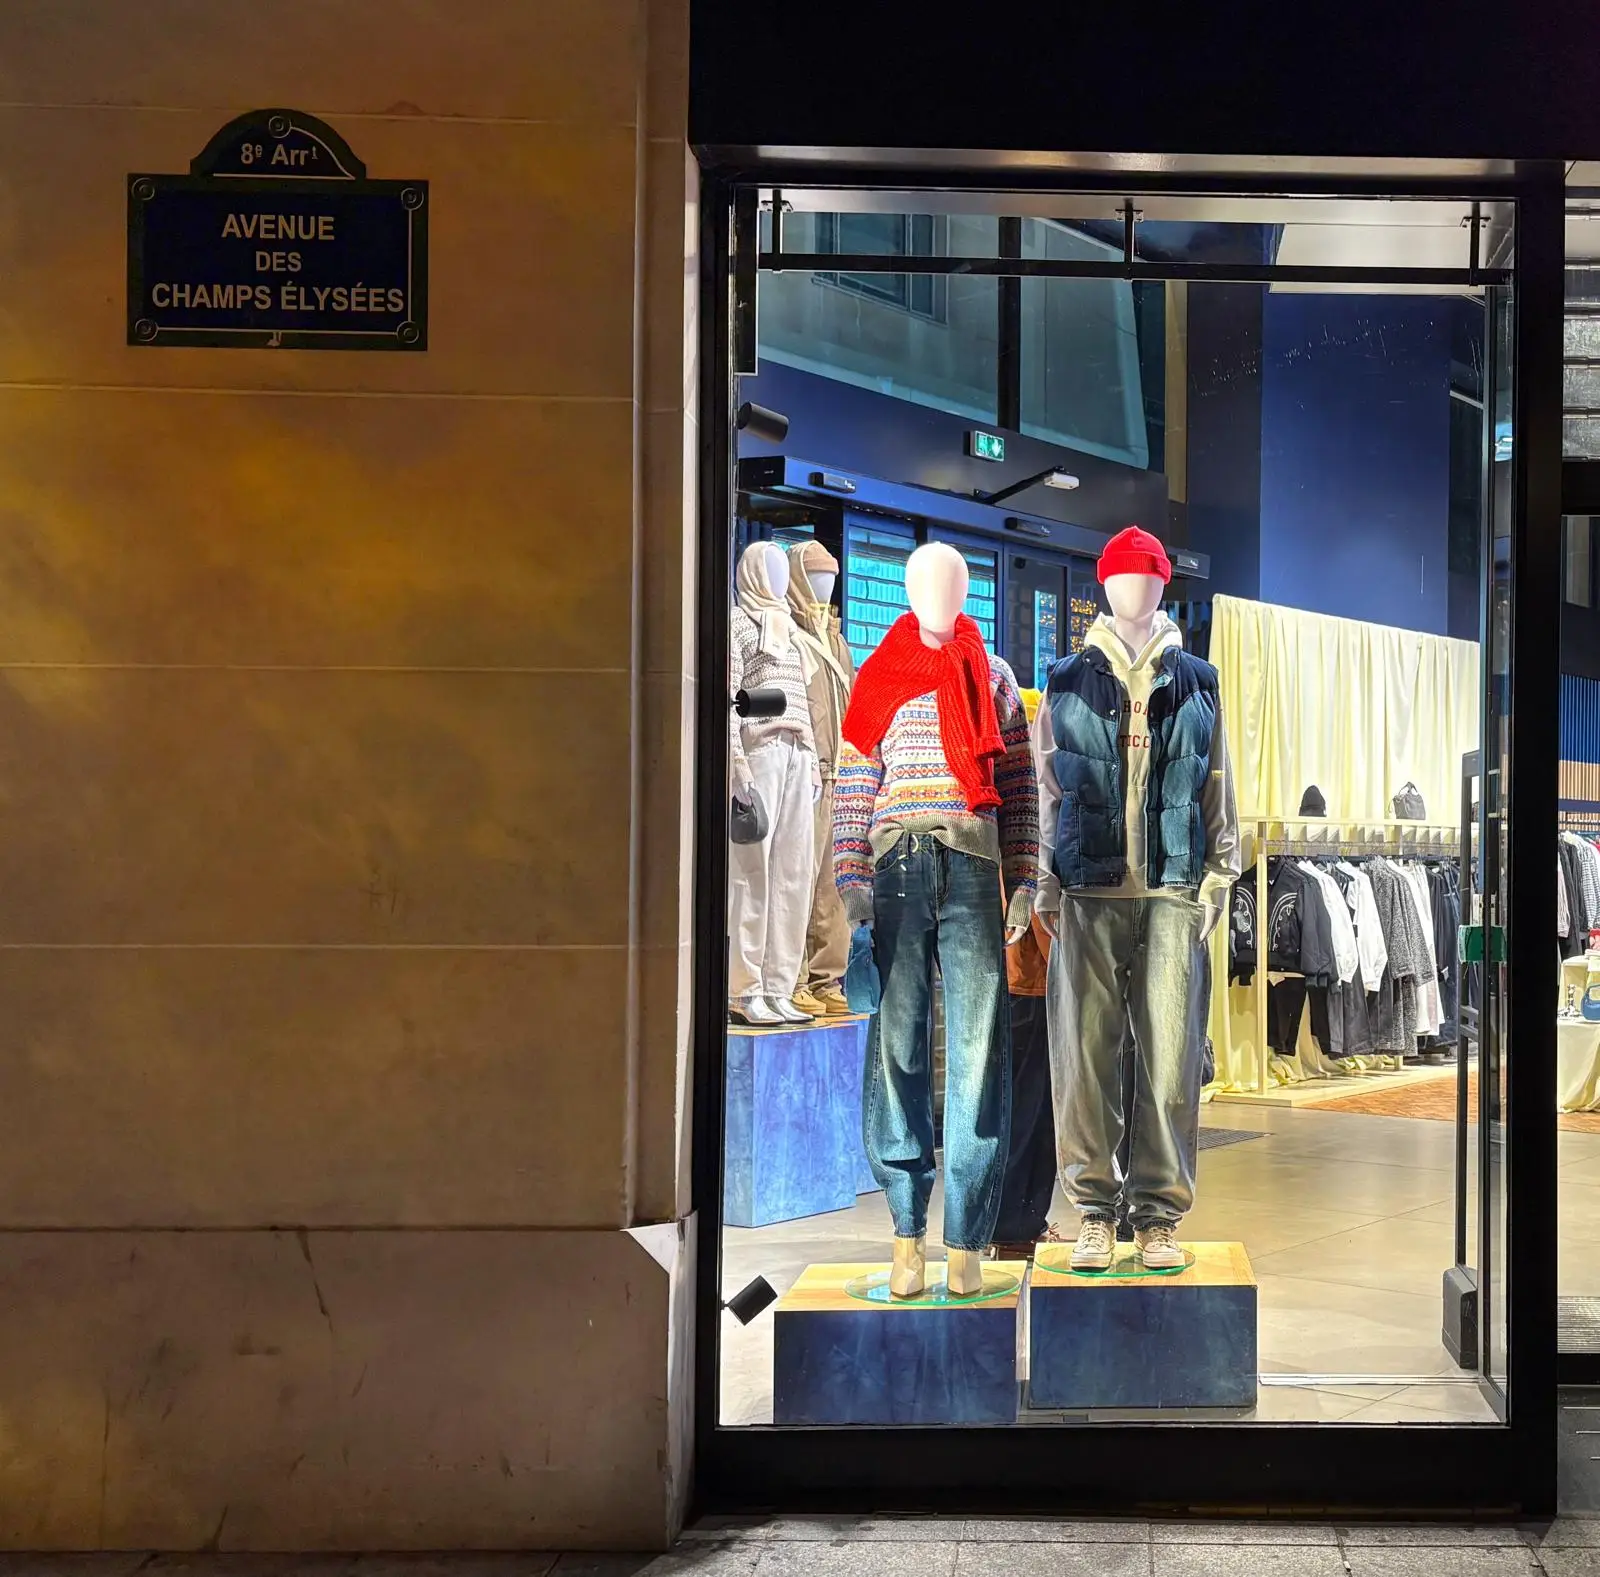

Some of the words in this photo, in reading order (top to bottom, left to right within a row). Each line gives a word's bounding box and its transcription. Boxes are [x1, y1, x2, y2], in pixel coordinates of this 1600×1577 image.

[221, 214, 335, 240] AVENUE
[255, 251, 302, 272] DES
[152, 283, 271, 309] CHAMPS
[280, 280, 404, 312] ÉLYSÉES
